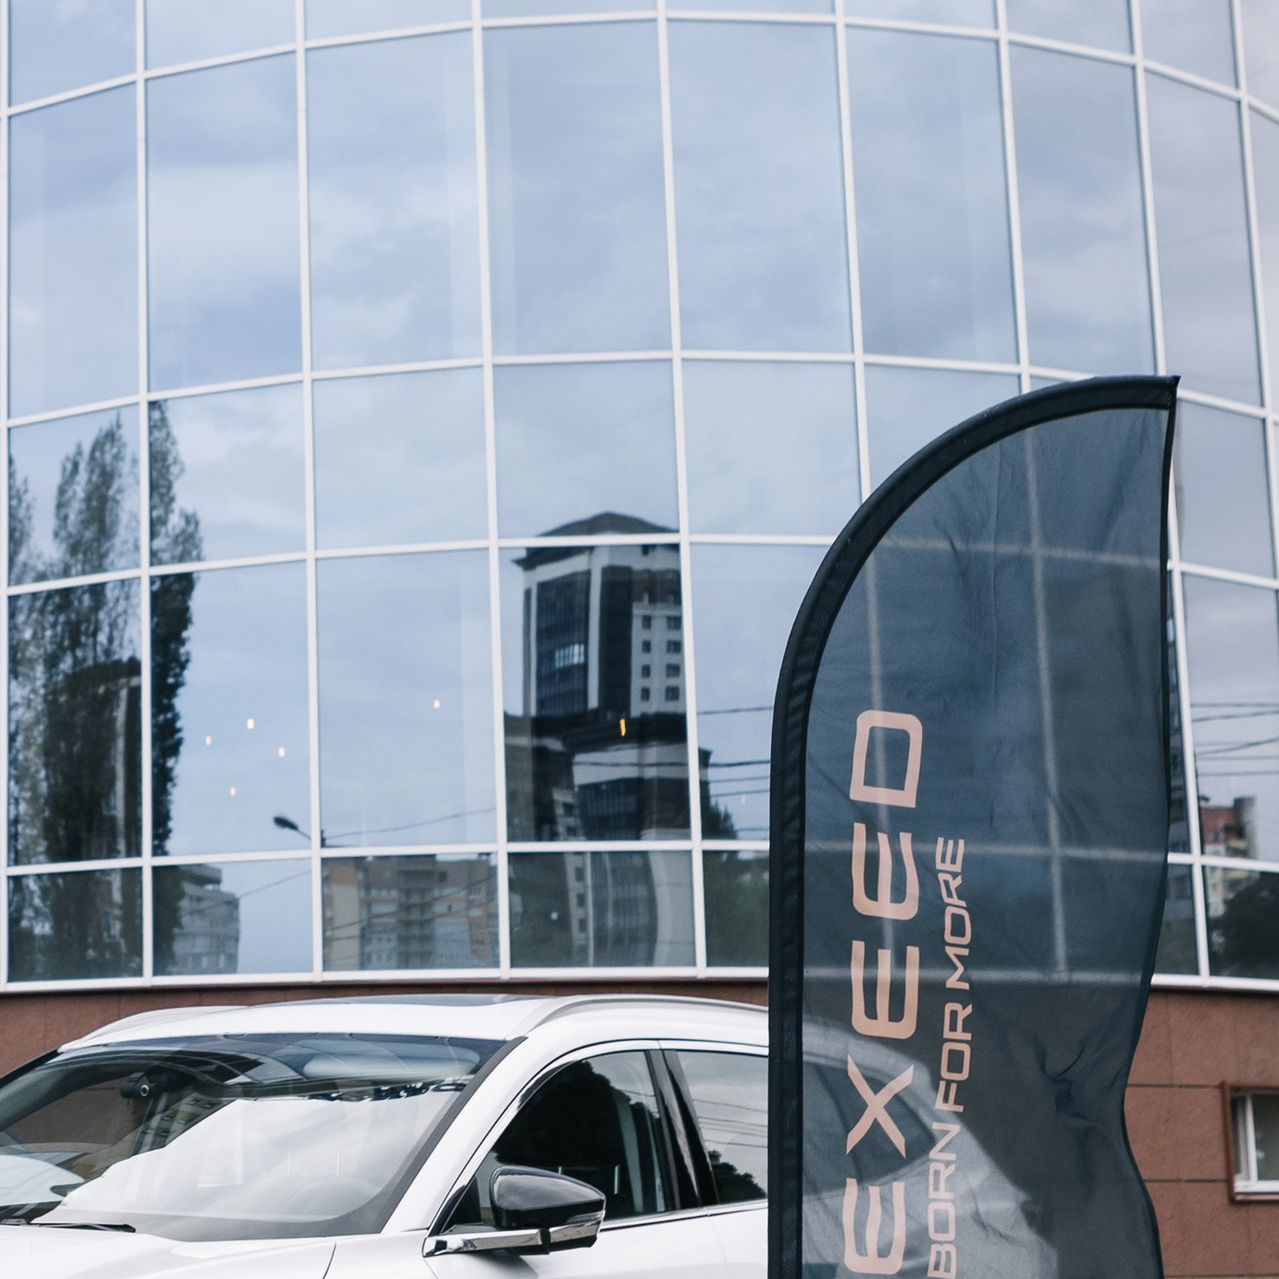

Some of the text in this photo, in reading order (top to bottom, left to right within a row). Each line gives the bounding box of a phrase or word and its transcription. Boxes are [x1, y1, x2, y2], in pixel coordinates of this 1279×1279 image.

[842, 709, 923, 1276] EXEED
[926, 836, 973, 1279] BORN FOR MORE
